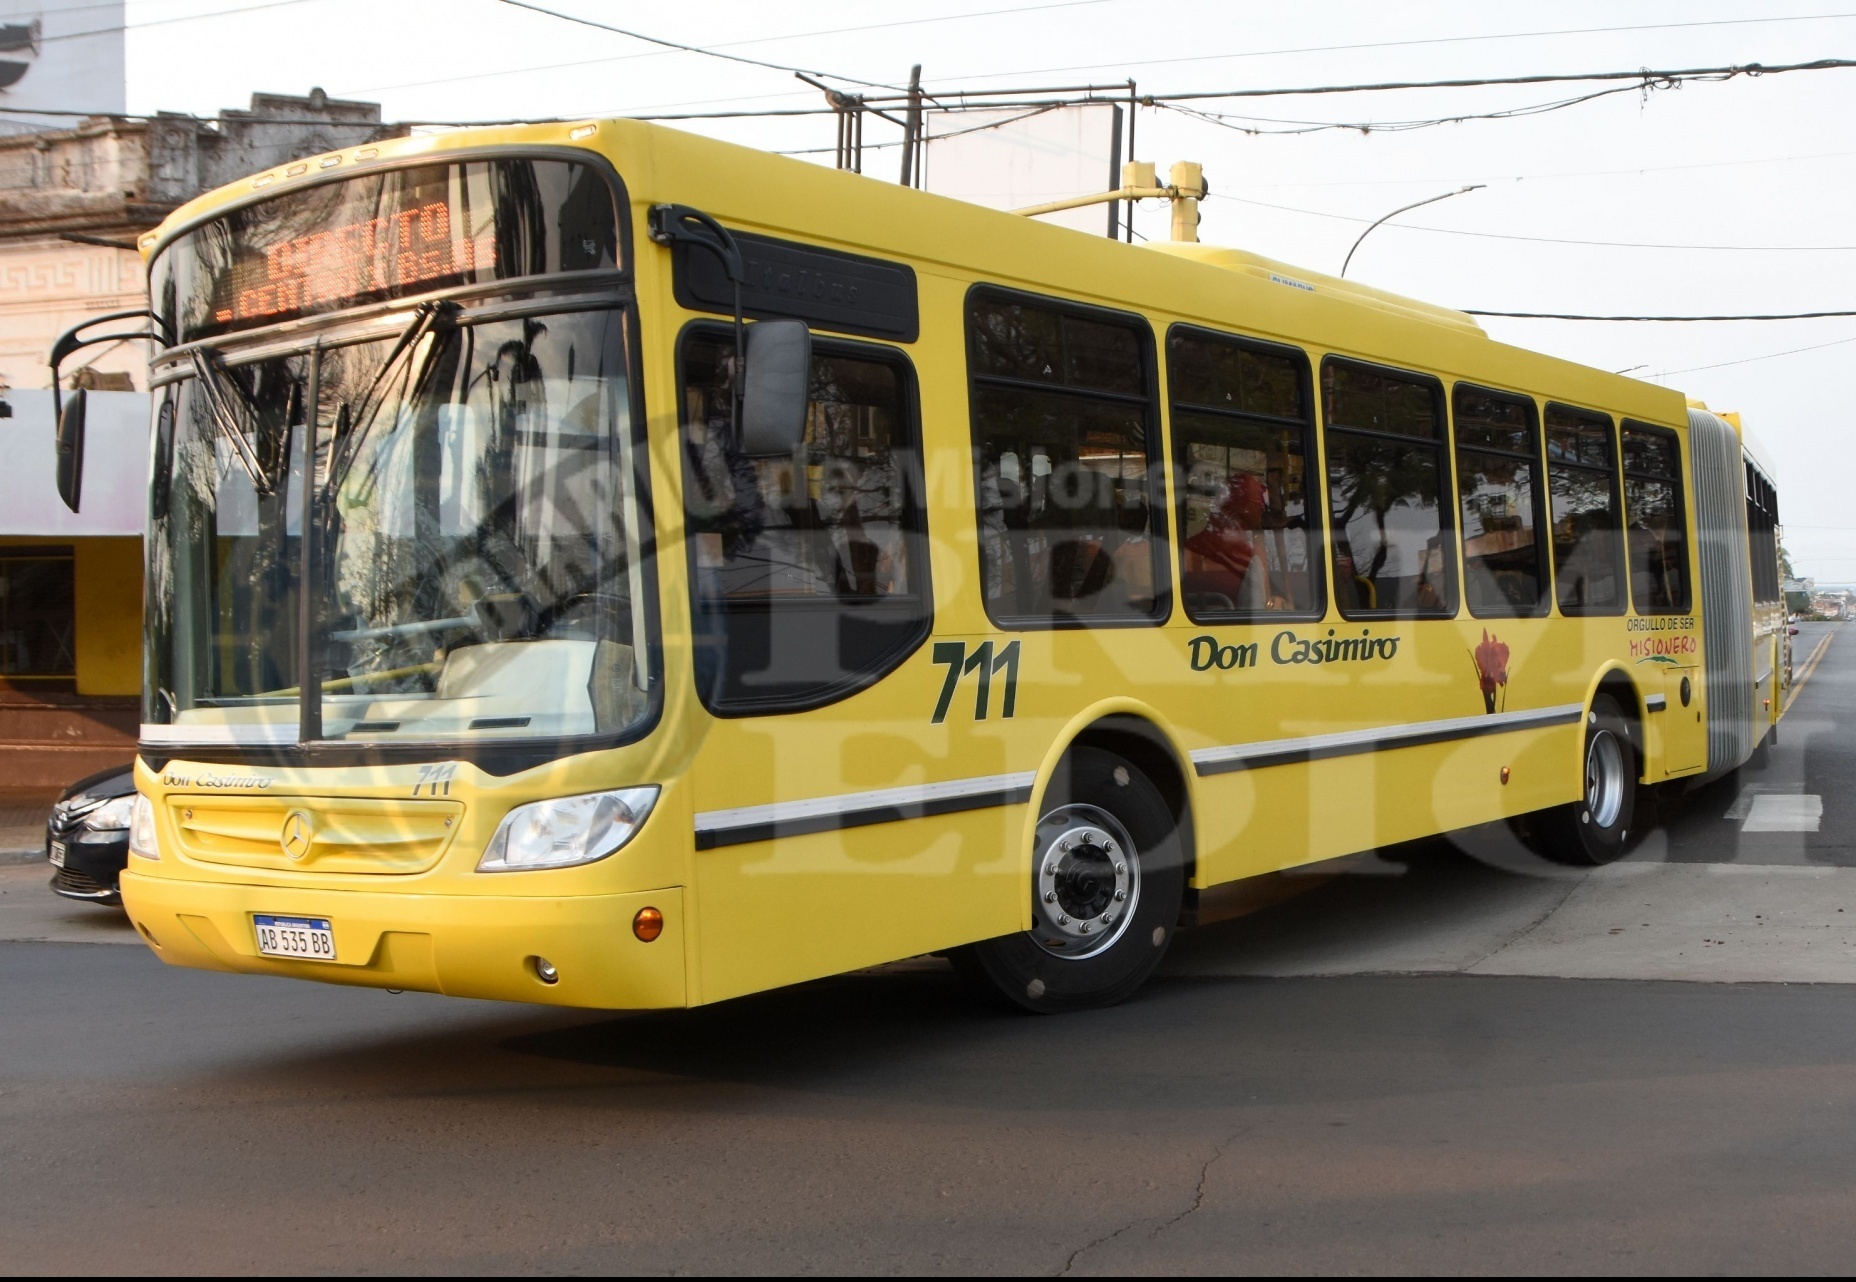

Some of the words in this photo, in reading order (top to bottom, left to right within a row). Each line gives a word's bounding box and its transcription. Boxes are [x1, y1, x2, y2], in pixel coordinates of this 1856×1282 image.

[1627, 618, 1666, 632] ORGULLO
[1667, 617, 1678, 630] DE
[1679, 617, 1695, 630] SER
[1187, 635, 1258, 672] Don
[1270, 628, 1401, 665] Casimiro
[1629, 635, 1697, 657] MISIONERO
[930, 640, 1021, 725] 711
[162, 771, 190, 787] Don
[195, 772, 275, 790] Casimiro
[411, 764, 457, 797] 711
[261, 929, 278, 950] AB
[280, 930, 308, 953] 535
[311, 932, 330, 954] BB
